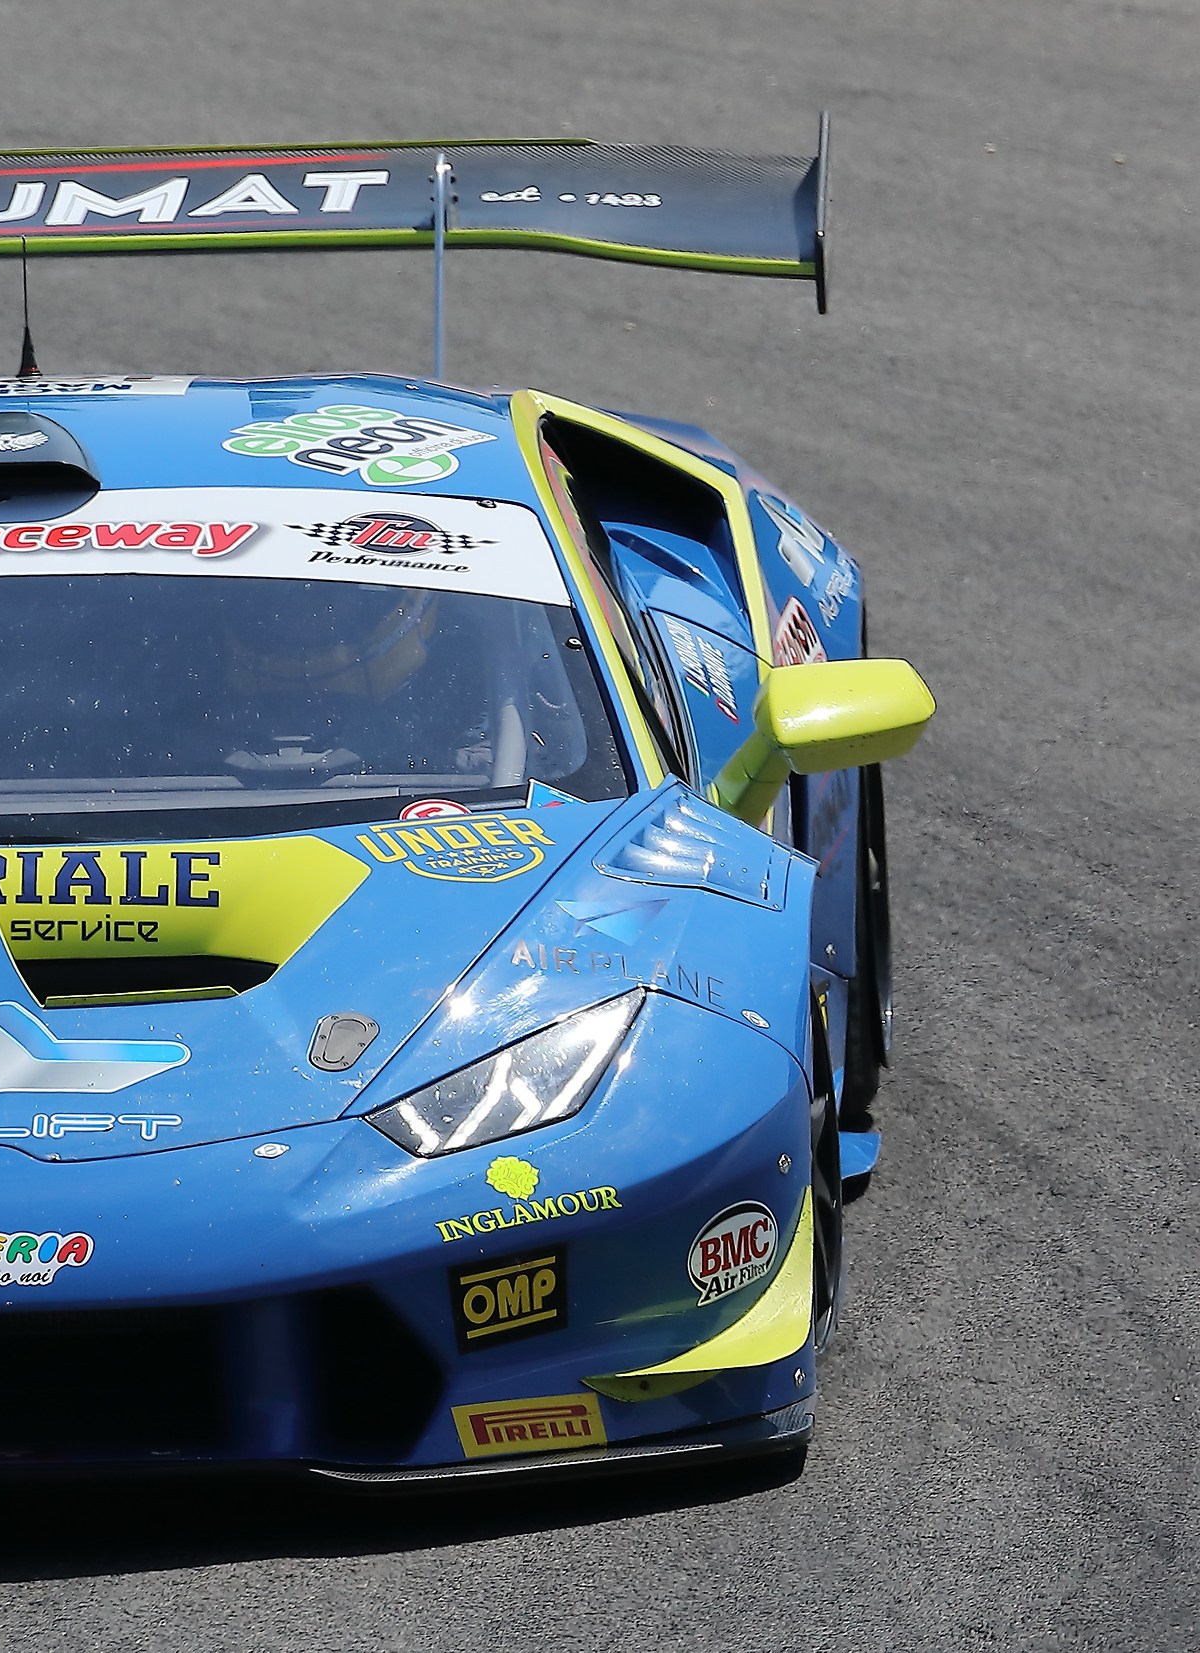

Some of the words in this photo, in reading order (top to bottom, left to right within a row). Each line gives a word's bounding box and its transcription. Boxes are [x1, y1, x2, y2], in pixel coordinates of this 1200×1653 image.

[229, 406, 397, 453] elios
[295, 418, 468, 471] neon
[307, 550, 471, 573] Performance
[356, 817, 557, 864] UNDER
[425, 850, 526, 870] TRAINING
[10, 914, 159, 943] service
[511, 939, 725, 1009] AIRPLANE
[434, 1185, 623, 1243] INGLAMOUR
[699, 1217, 770, 1278] BMC
[19, 1269, 53, 1284] noi
[463, 1269, 556, 1325] OMP
[700, 1272, 738, 1303] Air
[469, 1404, 592, 1446] PIRELLI
